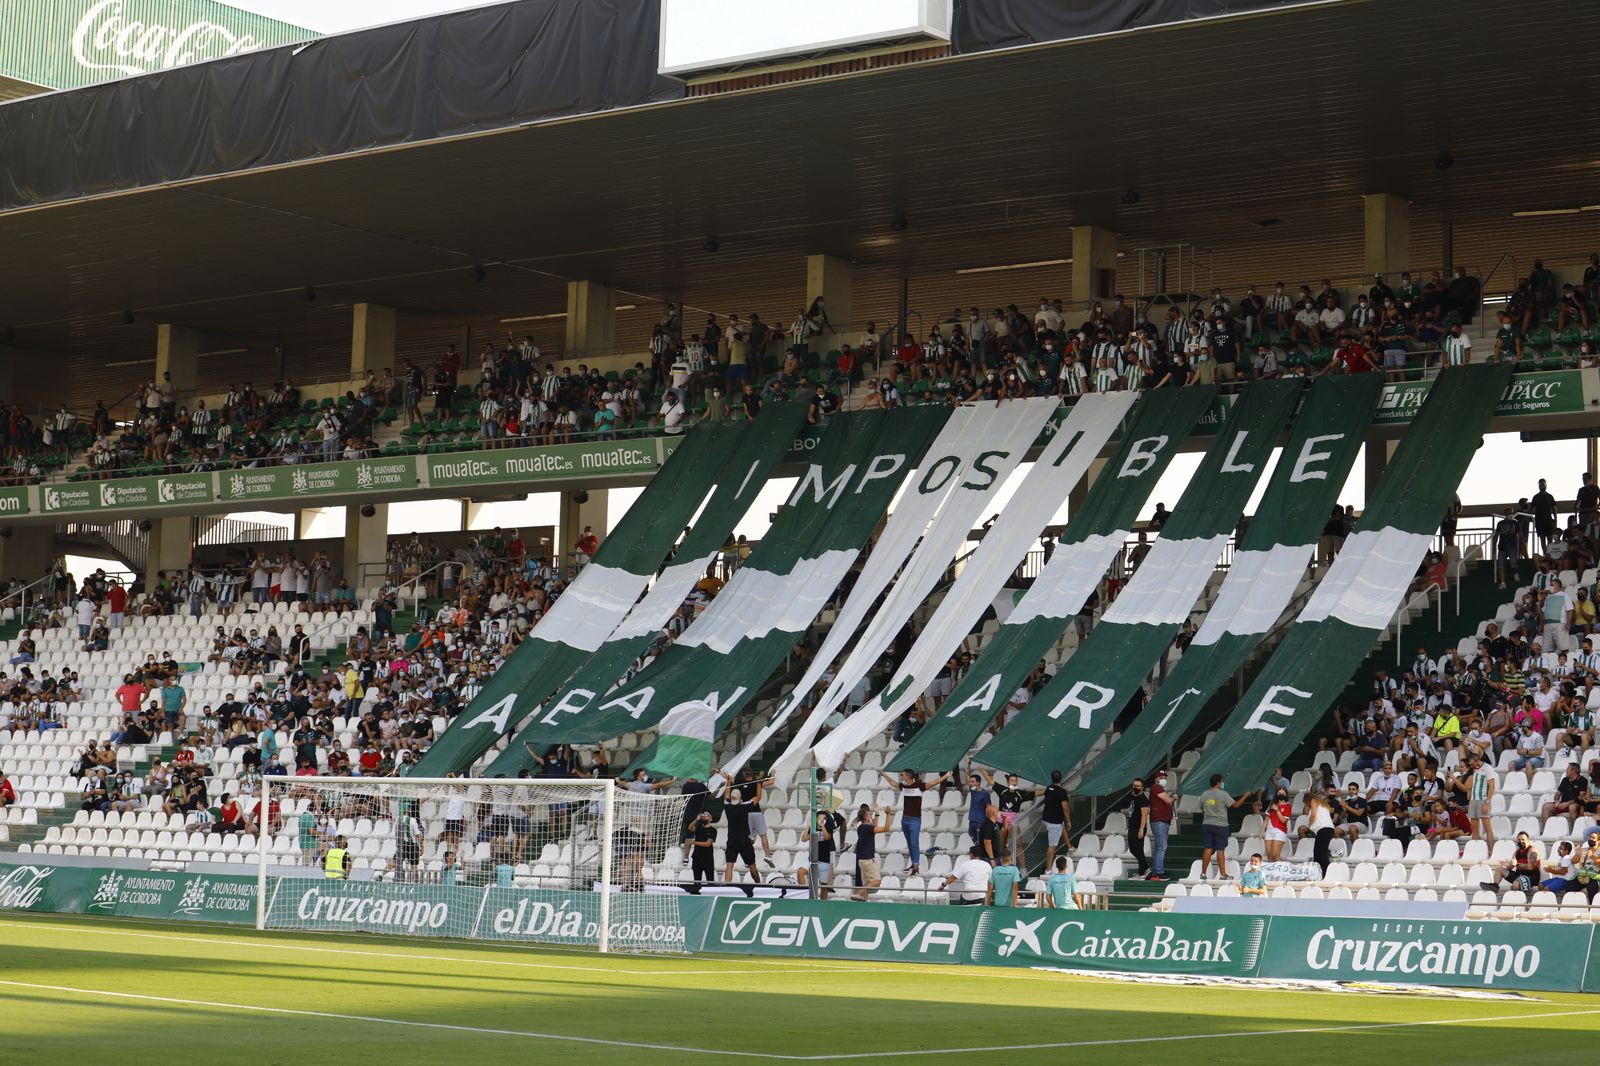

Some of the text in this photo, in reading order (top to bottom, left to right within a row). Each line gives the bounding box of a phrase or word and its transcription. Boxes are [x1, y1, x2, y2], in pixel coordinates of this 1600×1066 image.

[1507, 381, 1562, 400] PACC
[1513, 402, 1521, 410] de
[1522, 402, 1550, 411] Seguros
[308, 469, 339, 479] AYUNTAMIENTO
[373, 465, 406, 474] AYUNTAMIENTO
[245, 474, 276, 484] AYUNTAMIENTO
[374, 476, 380, 484] DE
[176, 482, 206, 491] Diputación
[245, 485, 251, 493] DE
[309, 480, 314, 489] DE
[61, 490, 89, 499] Diputación
[117, 486, 147, 496] Diputación
[62, 499, 68, 507] de
[118, 495, 124, 503] de
[124, 876, 175, 891] AYUNTAMIENTO
[211, 882, 259, 896] AYUNTAMIENT
[119, 891, 128, 902] DE
[205, 897, 215, 909] DE
[298, 886, 448, 932] Cruzcampo
[608, 920, 686, 942] CÓRDOBA
[1373, 923, 1484, 936] DESDE 1904
[761, 915, 960, 955] GIVOVA
[1051, 921, 1233, 962] CaixaBank
[1306, 925, 1541, 984] Cruzcampo
